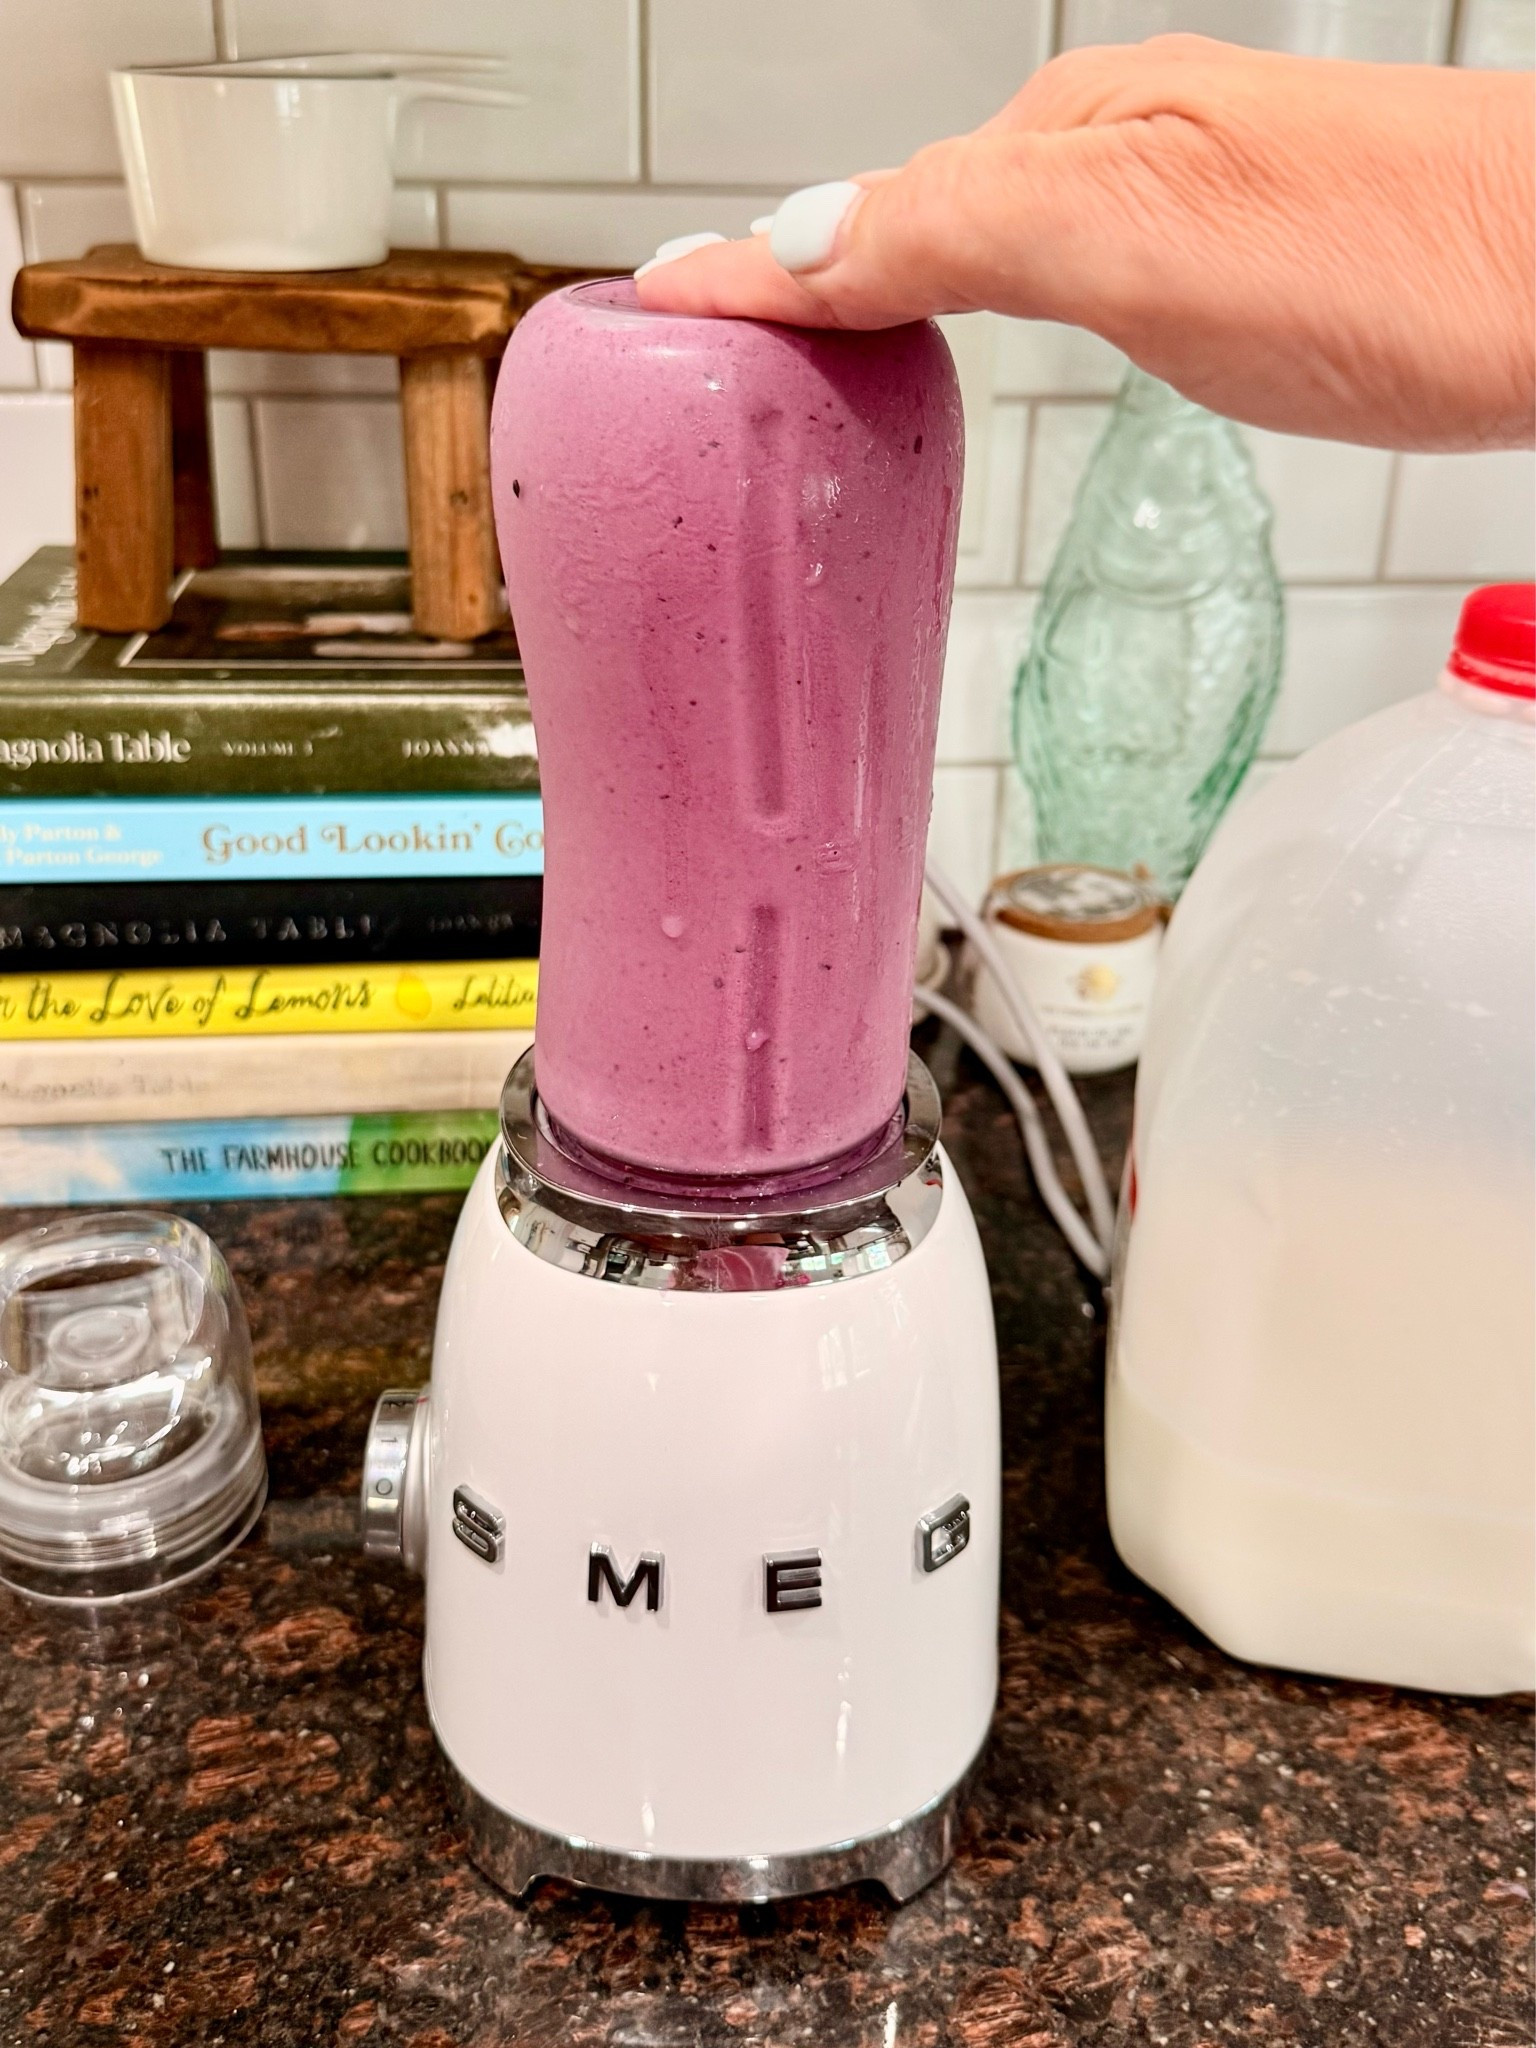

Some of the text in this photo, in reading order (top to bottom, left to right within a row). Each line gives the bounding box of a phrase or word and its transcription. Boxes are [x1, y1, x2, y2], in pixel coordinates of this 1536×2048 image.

[107, 729, 192, 763] Table
[23, 823, 100, 842] Parton
[201, 822, 308, 865] Good
[319, 820, 481, 855] Lookin'
[7, 846, 164, 869] Parton George
[27, 976, 82, 1022] the
[90, 971, 185, 1026] Love
[193, 973, 226, 1027] of
[234, 968, 374, 1020] Lemons
[161, 1136, 491, 1174] THE FARMHOUSE COOKBOO
